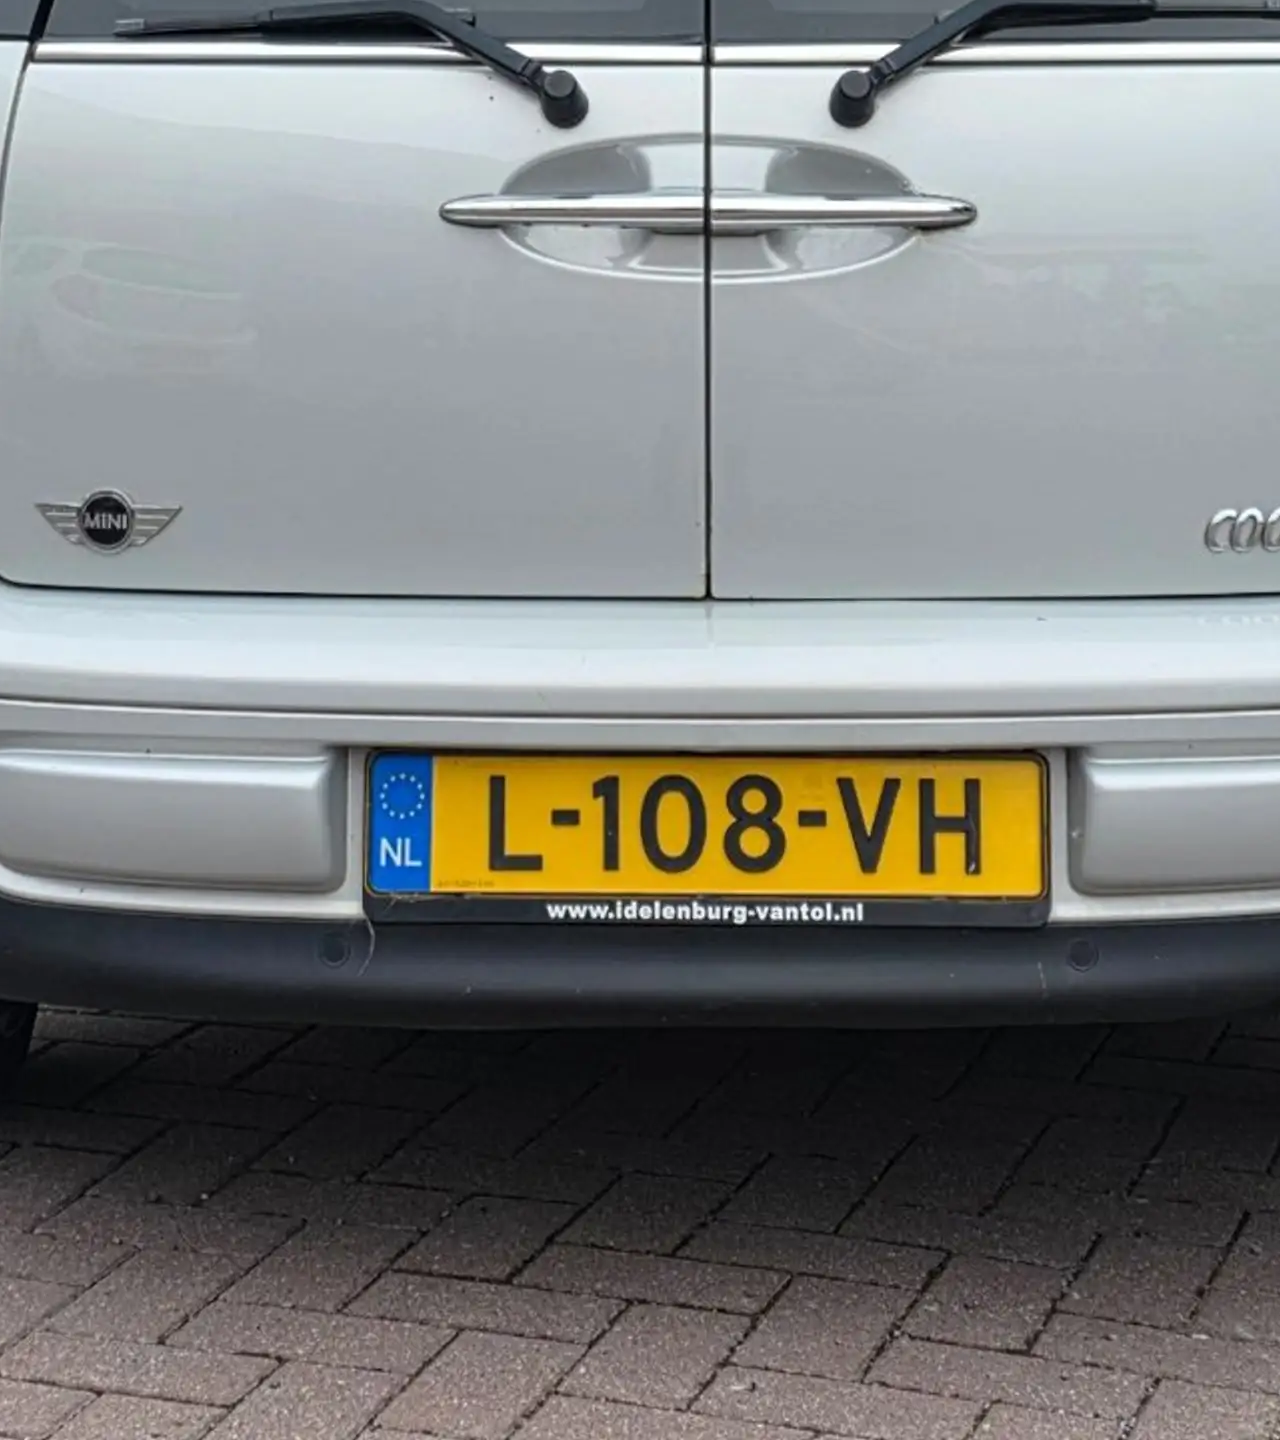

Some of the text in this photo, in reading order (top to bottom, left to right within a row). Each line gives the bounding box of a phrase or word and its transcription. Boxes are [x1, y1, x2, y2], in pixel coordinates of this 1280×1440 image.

[83, 512, 128, 530] MINI
[488, 773, 982, 876] L-108-VH
[379, 836, 422, 868] NL
[546, 900, 865, 925] www.idelenburg-vantol.nl
